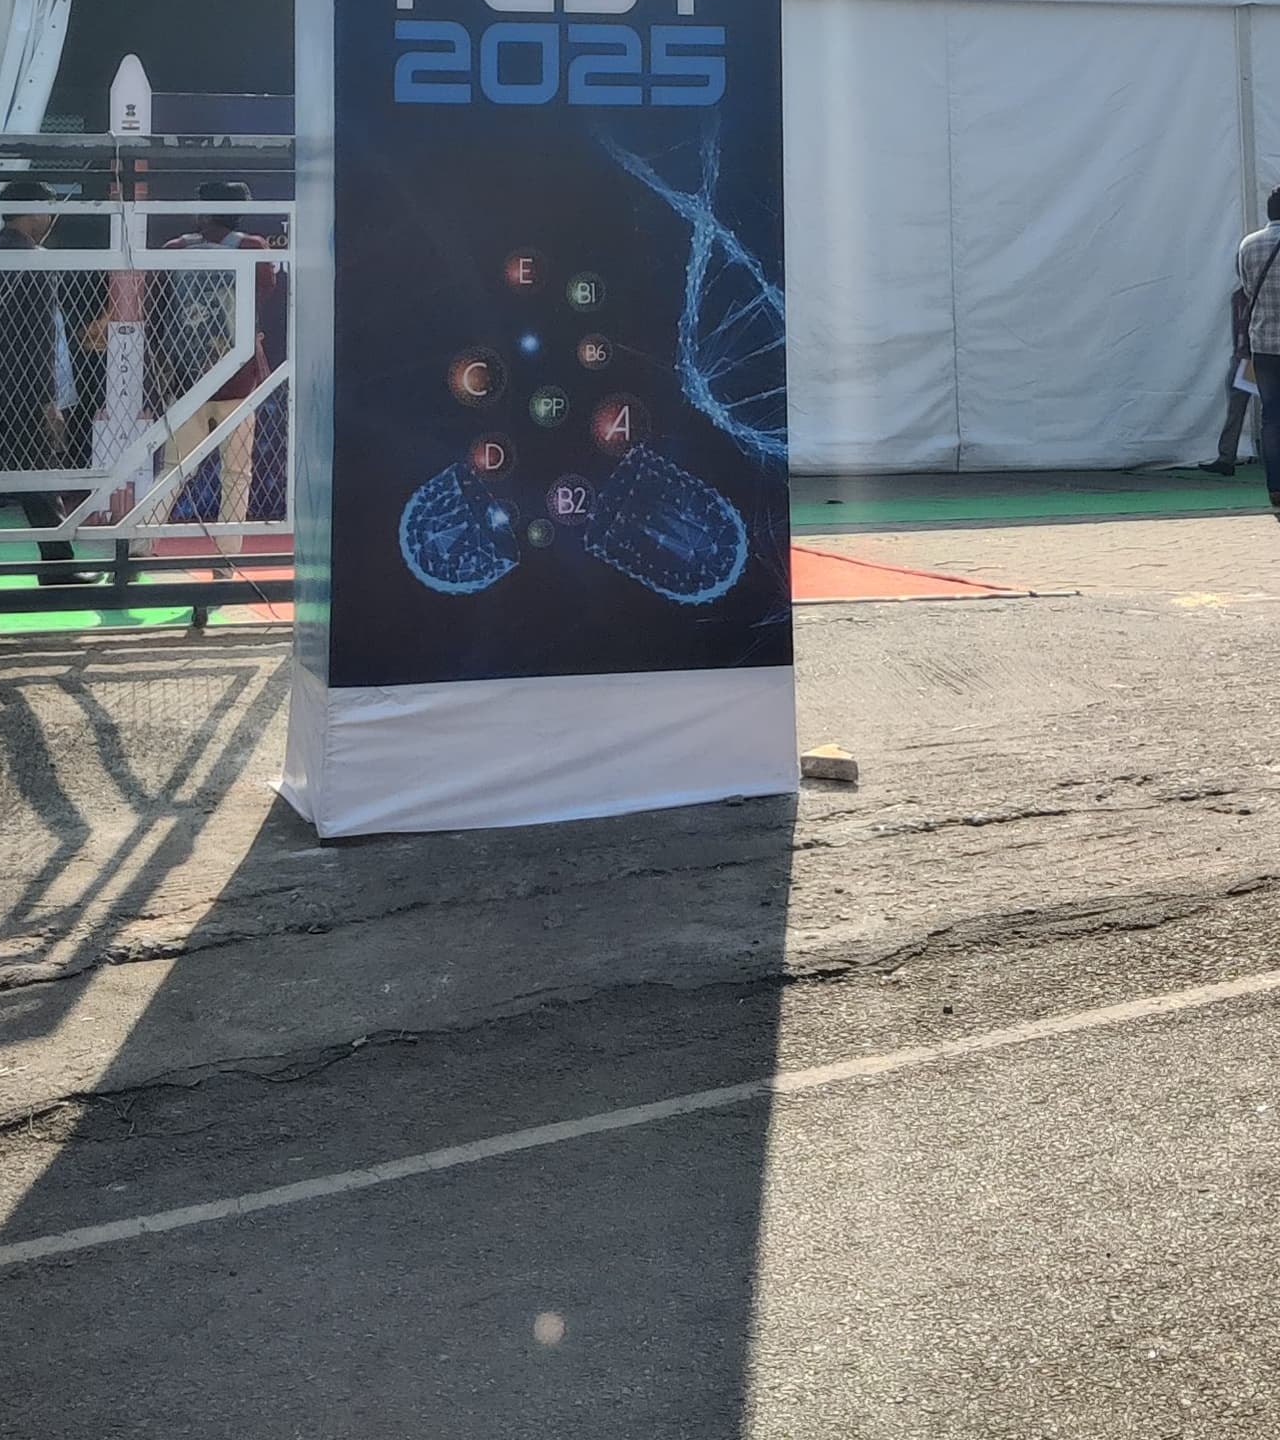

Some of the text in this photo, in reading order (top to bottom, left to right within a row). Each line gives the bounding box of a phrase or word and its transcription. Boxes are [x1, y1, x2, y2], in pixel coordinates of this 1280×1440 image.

[394, 19, 727, 107] 2025
[518, 258, 533, 284] E
[577, 282, 596, 304] B1
[586, 343, 607, 363] B6
[462, 361, 488, 397] C
[540, 398, 566, 417] PP
[605, 405, 631, 442] A
[484, 443, 505, 470] D
[557, 486, 588, 516] B2
